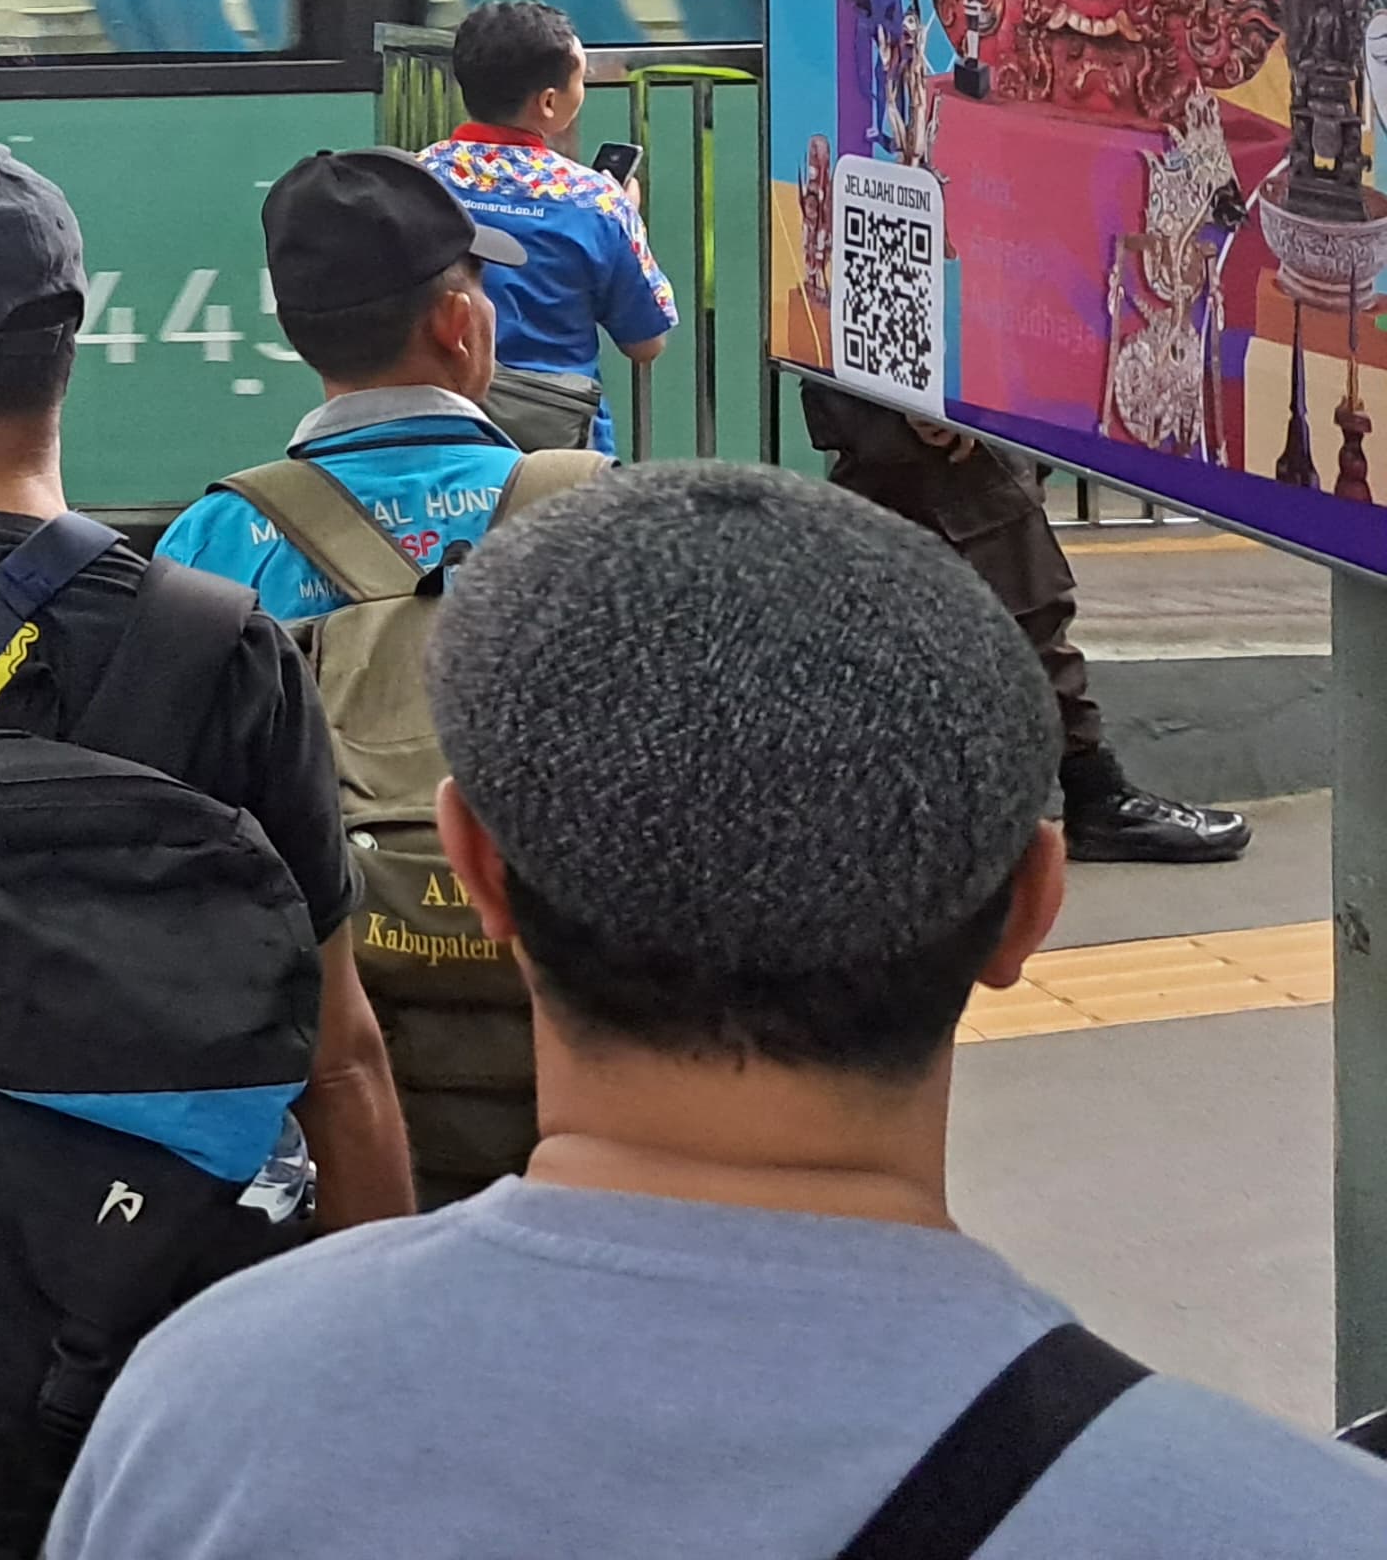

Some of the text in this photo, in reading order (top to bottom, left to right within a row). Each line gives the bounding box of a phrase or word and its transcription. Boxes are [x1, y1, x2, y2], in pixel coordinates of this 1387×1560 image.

[845, 173, 931, 212] JELAJAHI DISINI
[363, 912, 499, 967] Kabupaten
